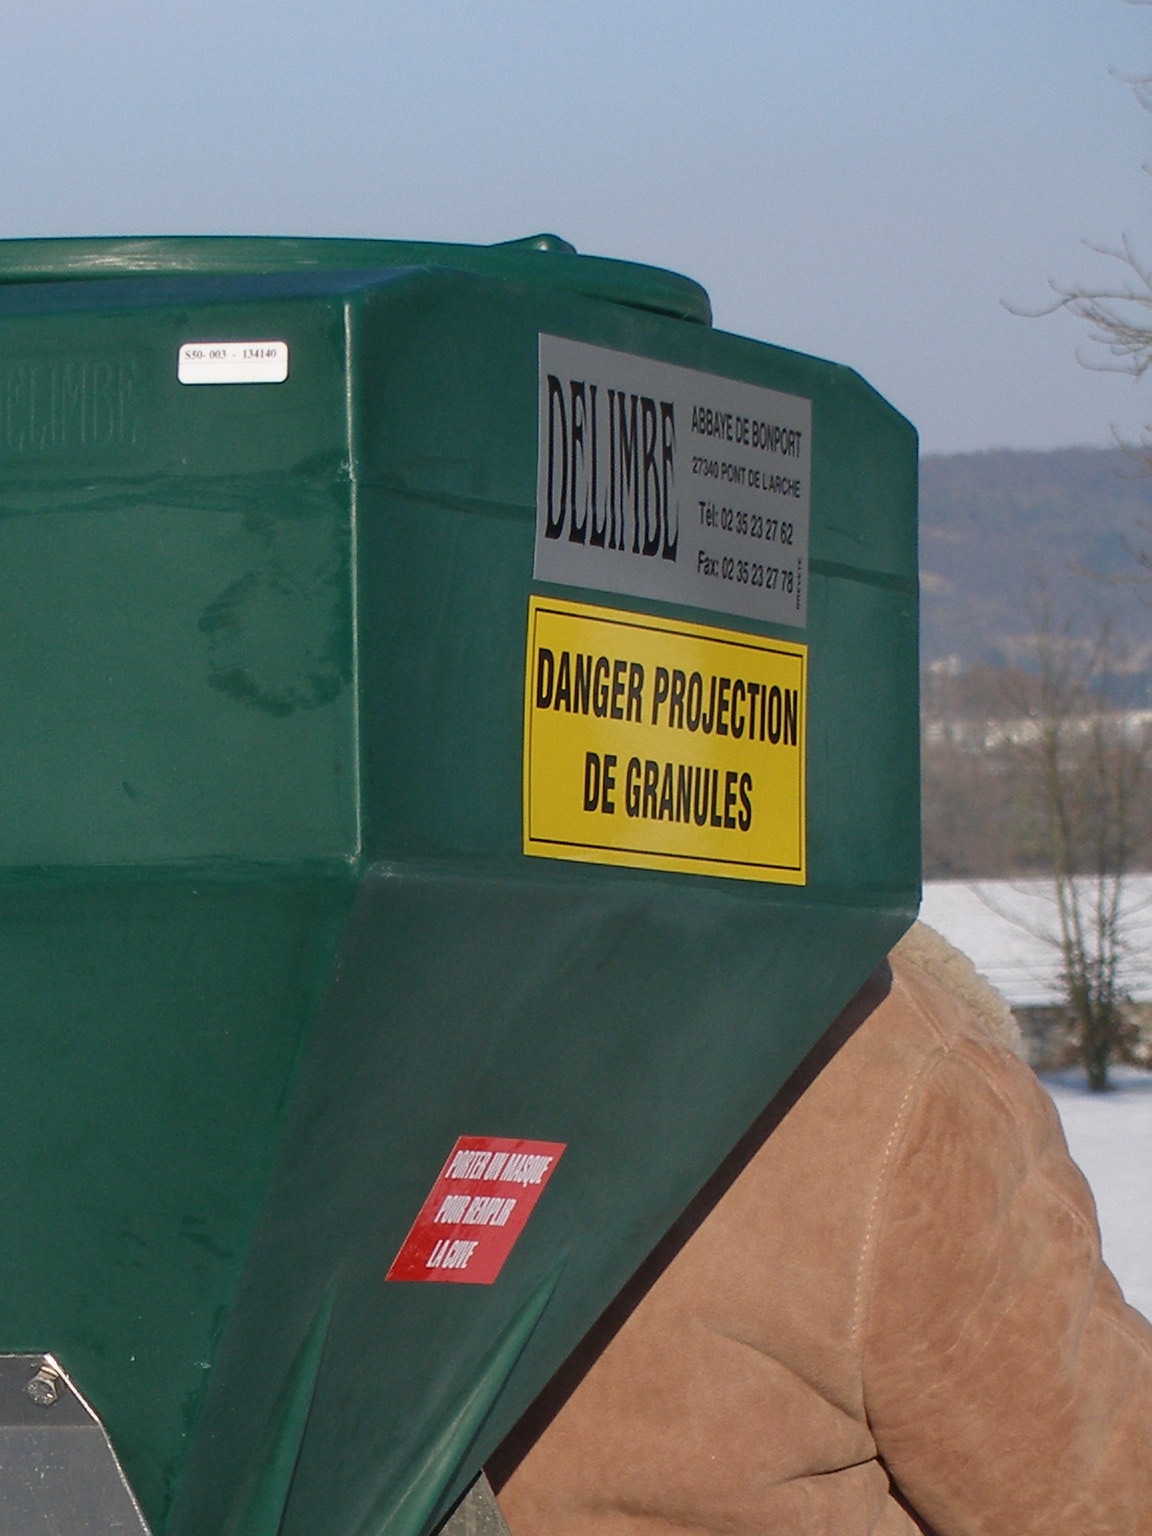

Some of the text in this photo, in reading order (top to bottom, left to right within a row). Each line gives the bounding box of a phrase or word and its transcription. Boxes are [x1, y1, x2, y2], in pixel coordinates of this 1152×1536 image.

[243, 348, 277, 359] 134140
[691, 404, 802, 458] ABBAYE DE BONPORT
[545, 374, 679, 562] DELIMBE
[691, 455, 719, 479] 27340
[720, 461, 746, 485] PONT
[748, 468, 760, 488] DE
[698, 501, 793, 545] Tél: 02 35 23 27 62
[697, 550, 794, 594] Fax: 02 35 23 27 78
[536, 647, 798, 747] DANGER PROJECTION
[583, 751, 753, 832] DE GRANULES
[445, 1150, 554, 1187] PORTER UN MASQUE
[434, 1195, 517, 1226] POUR REMPLIR
[425, 1239, 479, 1269] LA CUVE
